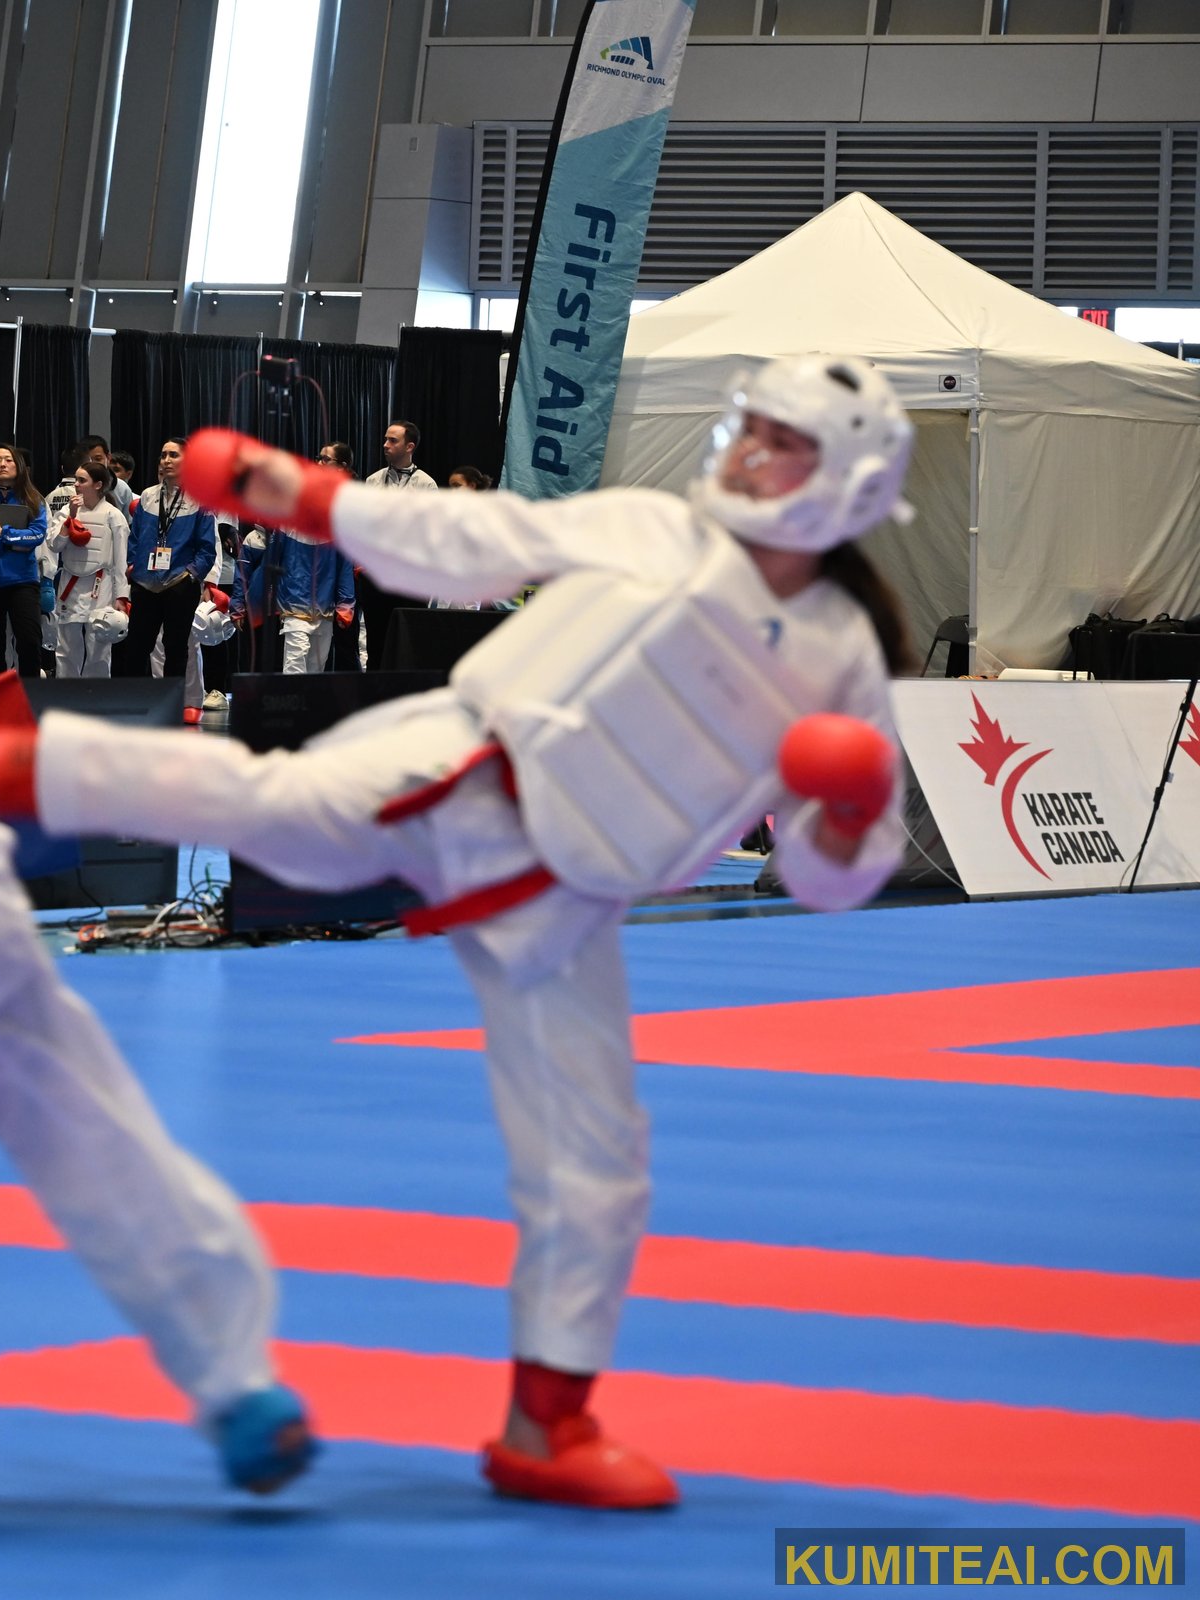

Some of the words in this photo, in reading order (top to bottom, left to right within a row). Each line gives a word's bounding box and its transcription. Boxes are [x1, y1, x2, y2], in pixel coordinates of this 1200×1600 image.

[587, 63, 620, 76] RICHMOND
[621, 71, 646, 82] OLYMPIC
[646, 76, 666, 86] OVAL
[550, 203, 616, 352] First
[531, 366, 584, 476] Aid
[53, 495, 70, 503] BRITIS
[1022, 792, 1104, 827] KARATE
[1041, 830, 1125, 865] CANADA
